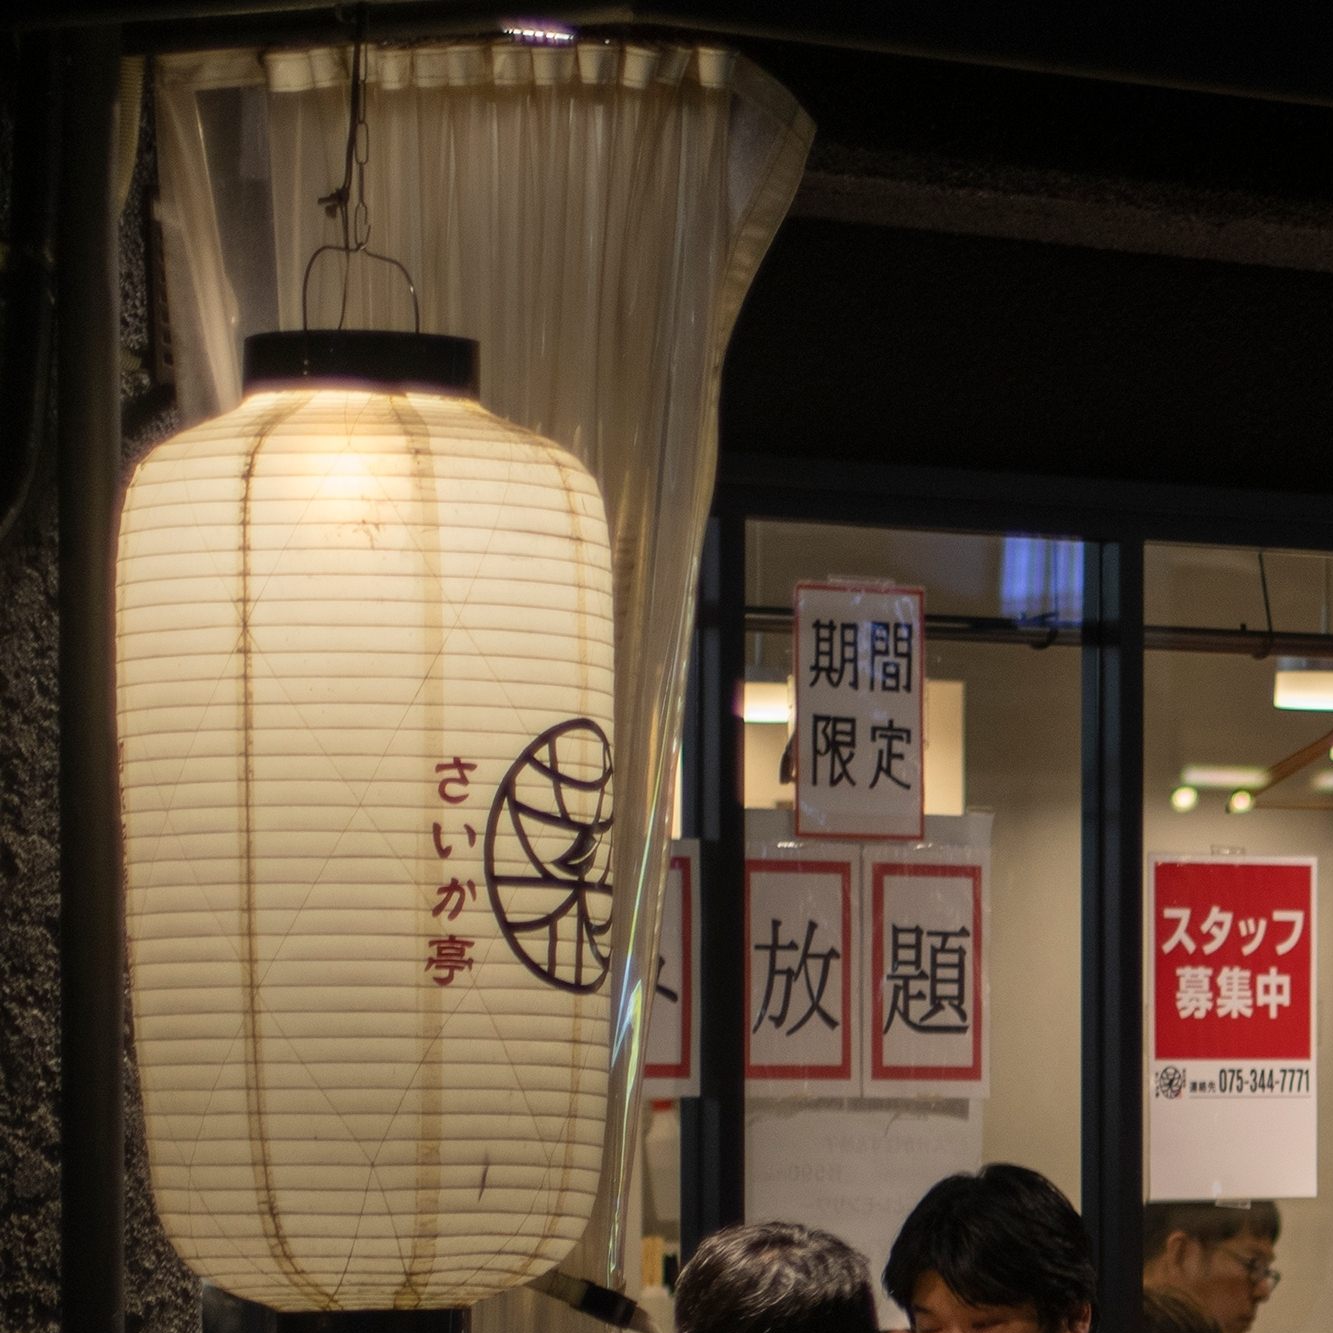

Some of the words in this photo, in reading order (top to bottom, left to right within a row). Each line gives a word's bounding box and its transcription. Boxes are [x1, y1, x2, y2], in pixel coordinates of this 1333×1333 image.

[808, 618, 913, 694] 期間
[810, 714, 913, 791] 限定
[423, 755, 478, 987] さいか亭
[1161, 905, 1306, 956] スタッフ
[1174, 965, 1292, 1020] 募集中
[1218, 1068, 1310, 1093] 075-344-7771
